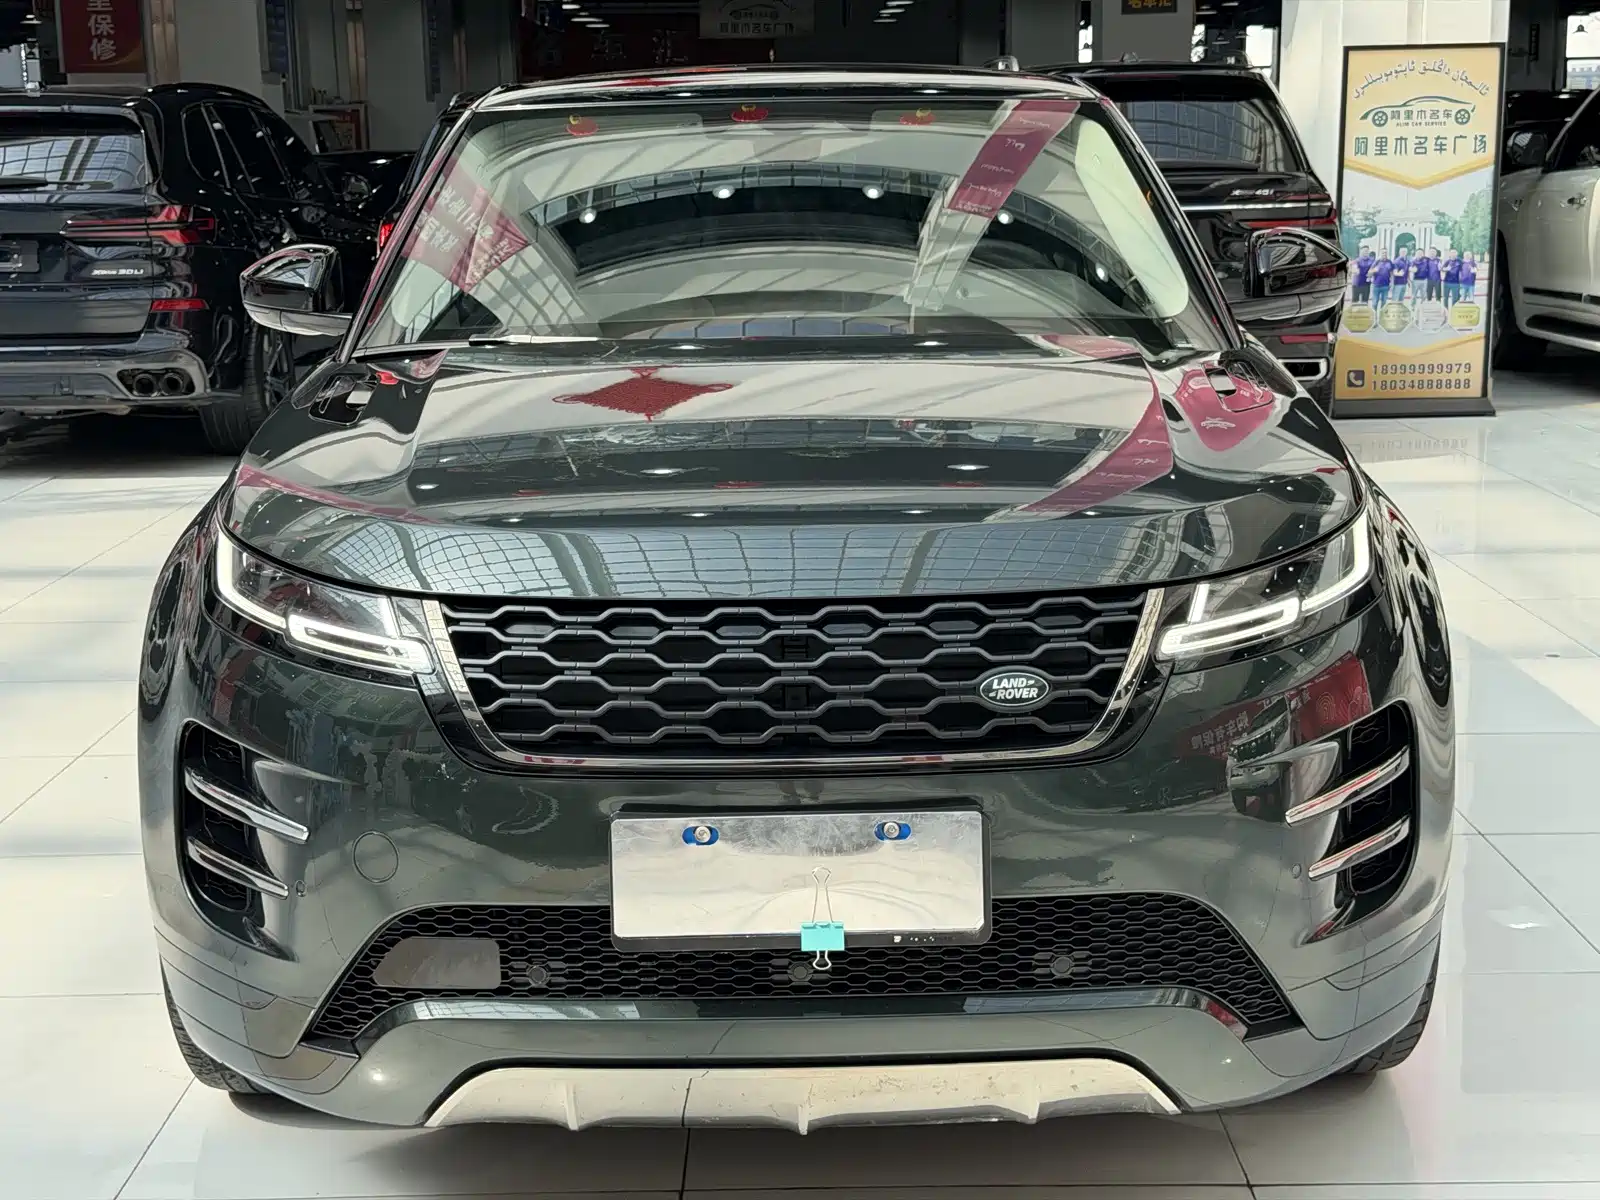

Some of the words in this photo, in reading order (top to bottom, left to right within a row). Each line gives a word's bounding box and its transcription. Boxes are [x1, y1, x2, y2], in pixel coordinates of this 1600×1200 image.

[1390, 109, 1453, 120] 阿里木名车
[1354, 135, 1487, 156] 阿里木名车广场
[1372, 362, 1472, 376] 18999999979
[1371, 378, 1471, 391] 18034888888
[992, 677, 1027, 689] LAND
[996, 688, 1038, 700] ROVER
